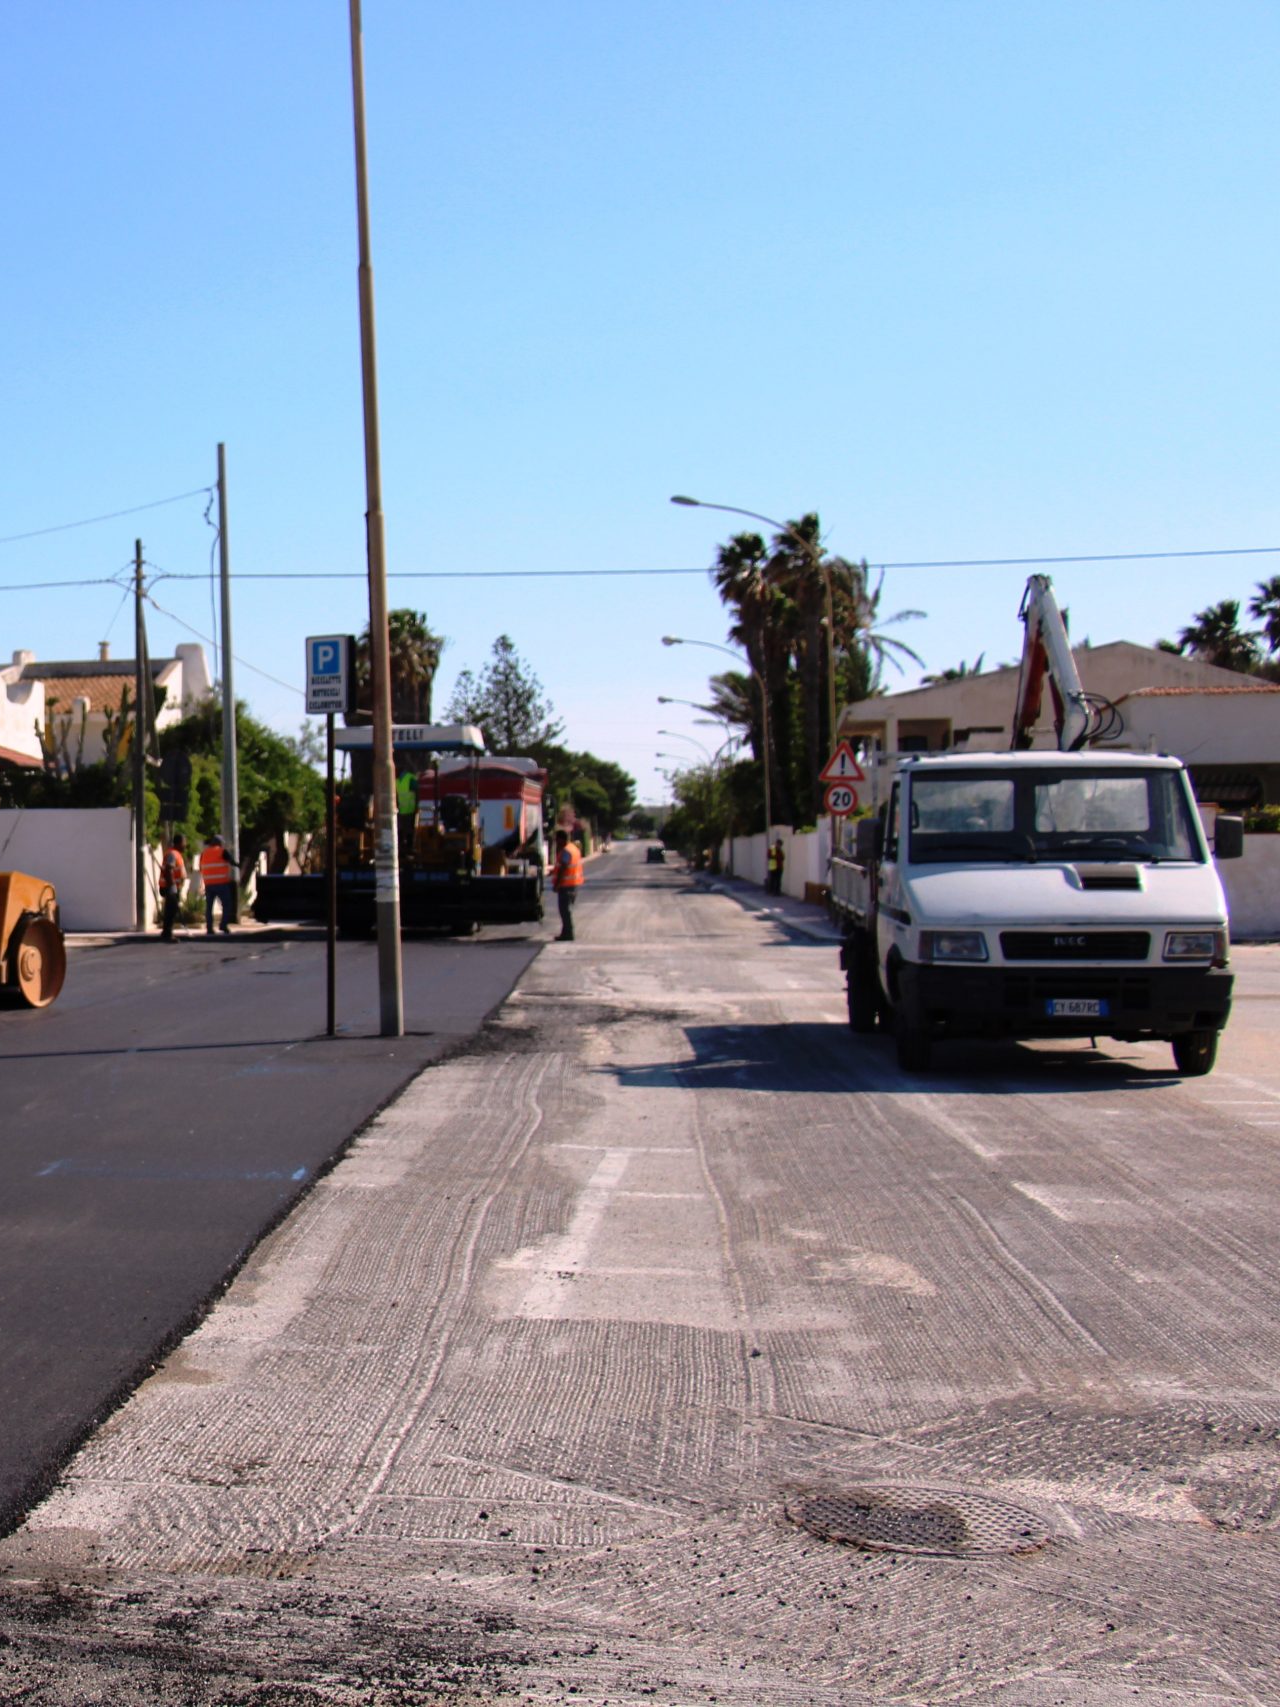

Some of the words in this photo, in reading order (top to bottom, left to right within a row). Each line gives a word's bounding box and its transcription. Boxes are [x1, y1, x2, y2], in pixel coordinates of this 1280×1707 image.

[318, 646, 333, 670] P
[391, 728, 424, 741] TELLI
[832, 791, 851, 807] 20
